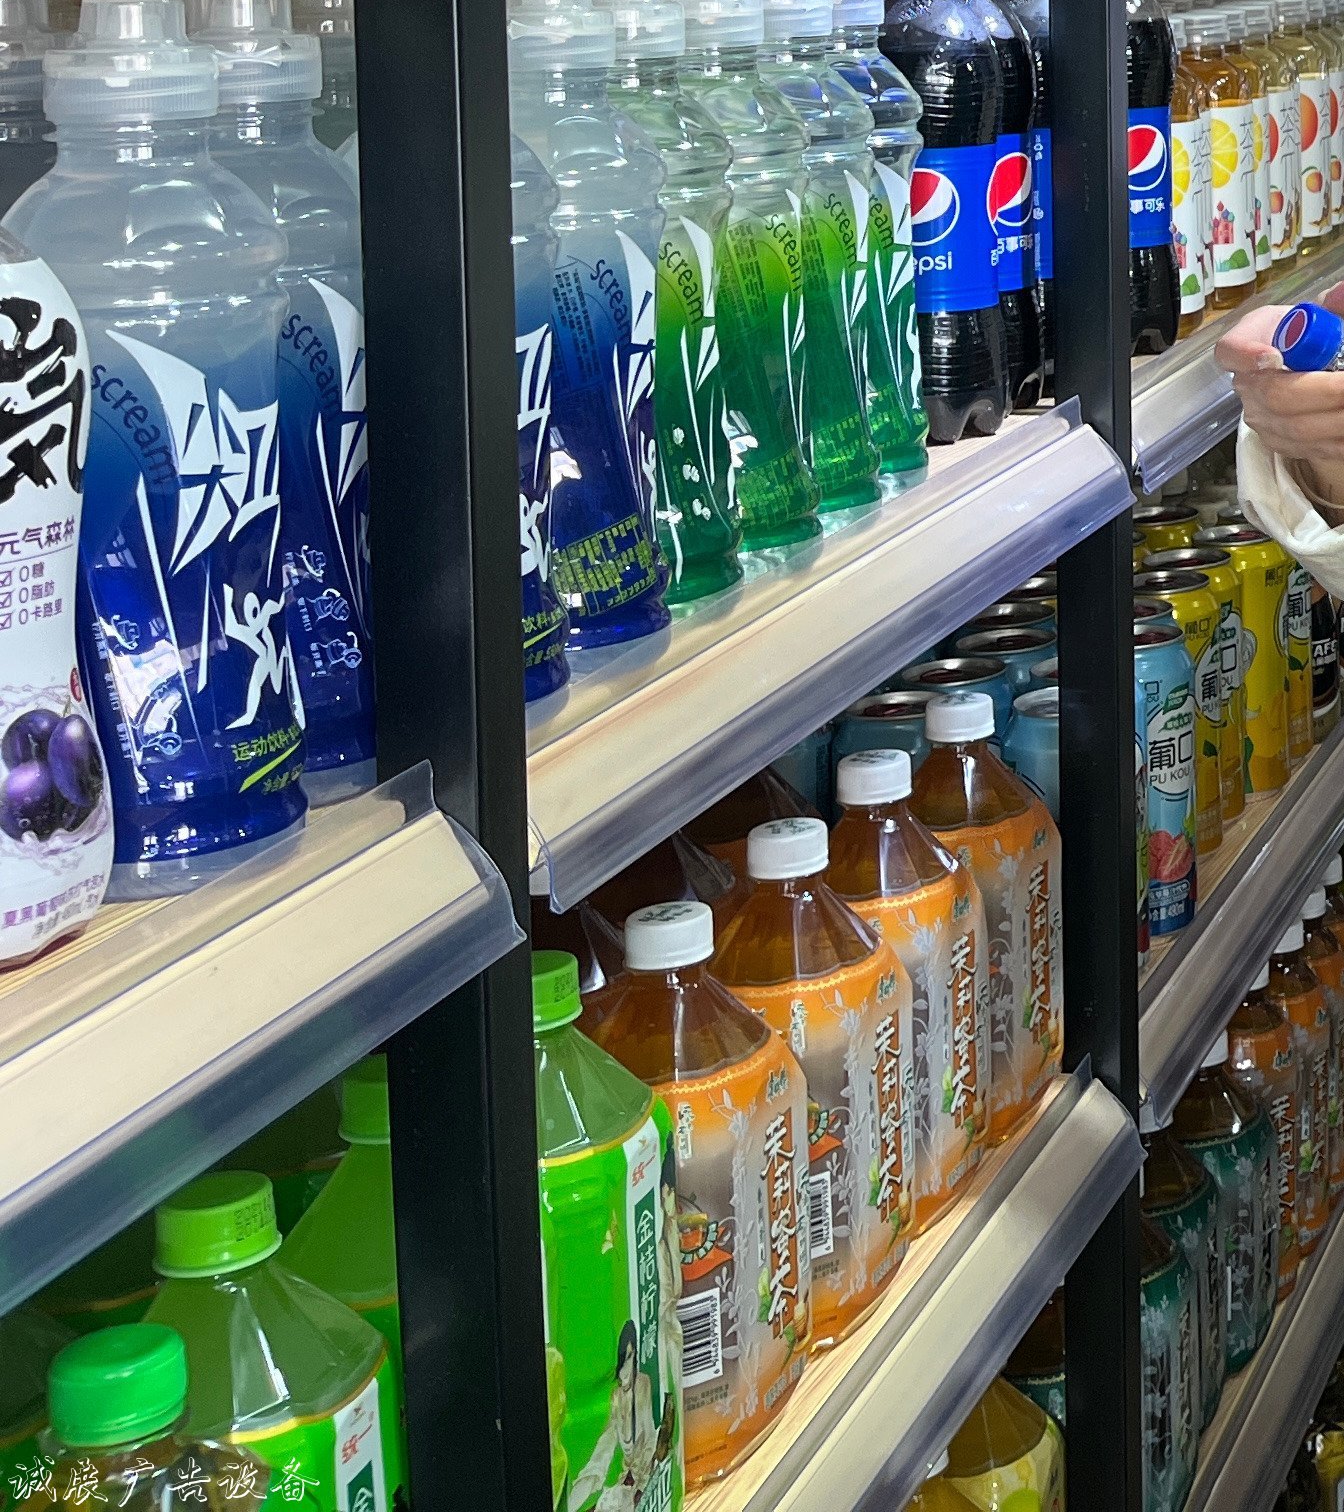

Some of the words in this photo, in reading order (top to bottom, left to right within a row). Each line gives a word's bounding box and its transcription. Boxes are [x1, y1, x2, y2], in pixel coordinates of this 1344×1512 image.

[658, 240, 704, 327] scream
[91, 362, 180, 490] scream
[18, 598, 63, 626] 0卡路里
[1149, 771, 1168, 785] PU
[635, 1210, 658, 1368] 金桔柠檬
